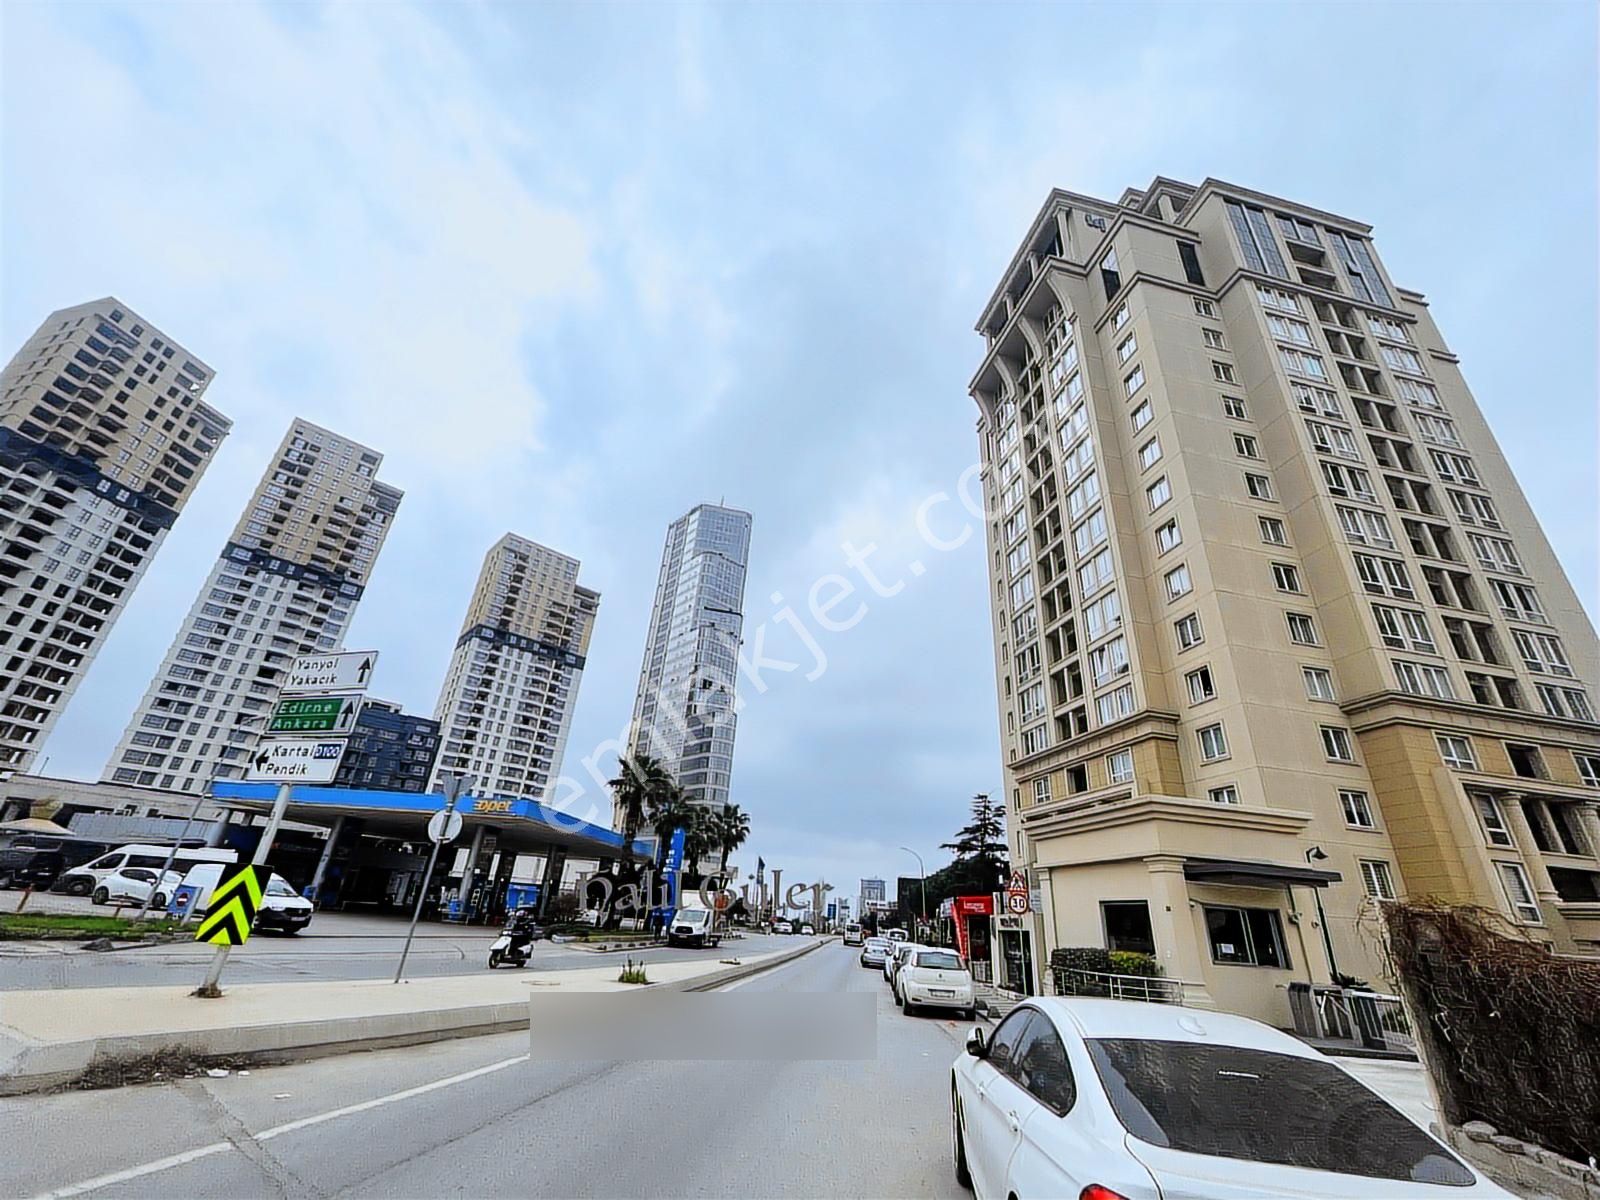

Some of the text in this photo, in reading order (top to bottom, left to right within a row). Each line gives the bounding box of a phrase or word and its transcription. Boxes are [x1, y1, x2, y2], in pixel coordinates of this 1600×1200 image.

[298, 657, 338, 671] Yanyol
[278, 702, 333, 714] Edirne
[272, 718, 328, 729] Ankara
[271, 745, 315, 757] Kartal
[265, 763, 309, 776] Pendik
[1012, 898, 1026, 909] 30
